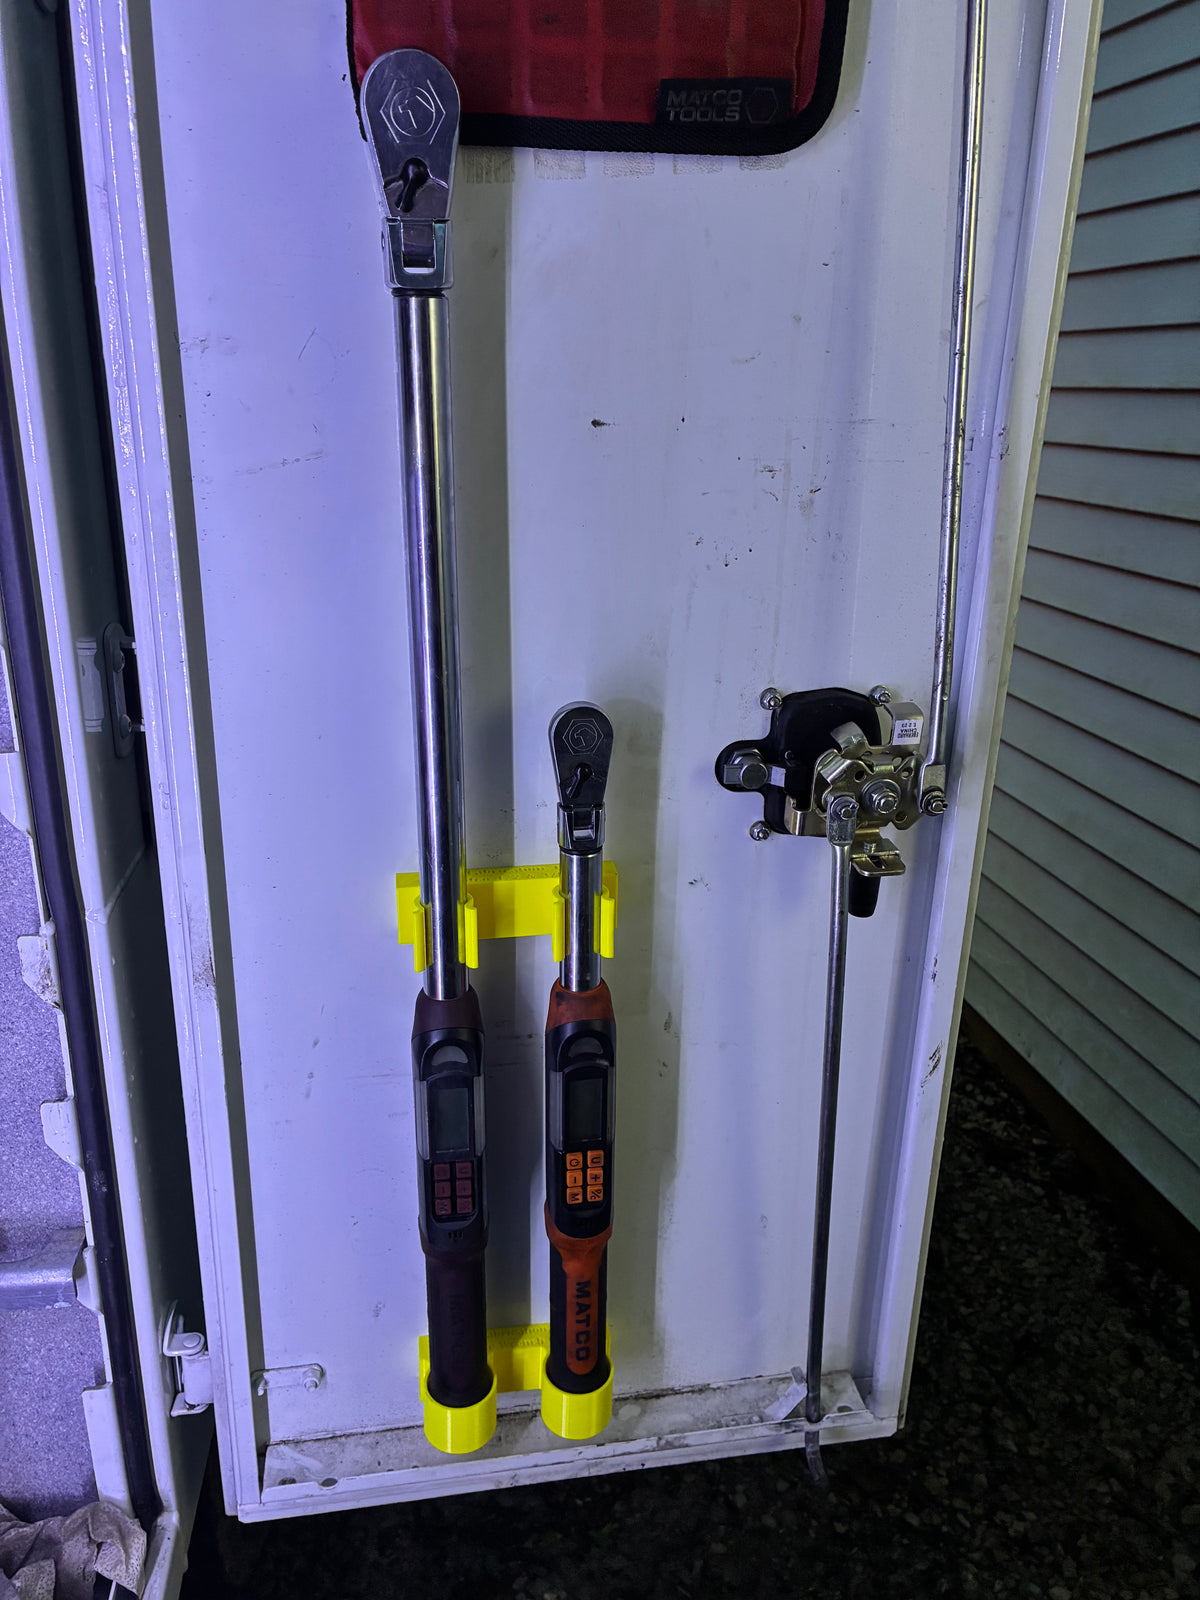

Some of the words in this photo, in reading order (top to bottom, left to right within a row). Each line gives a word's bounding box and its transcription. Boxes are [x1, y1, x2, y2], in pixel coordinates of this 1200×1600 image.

[667, 89, 742, 105] MATCO
[666, 106, 741, 122] TOOLS
[575, 1280, 592, 1362] MATCO
